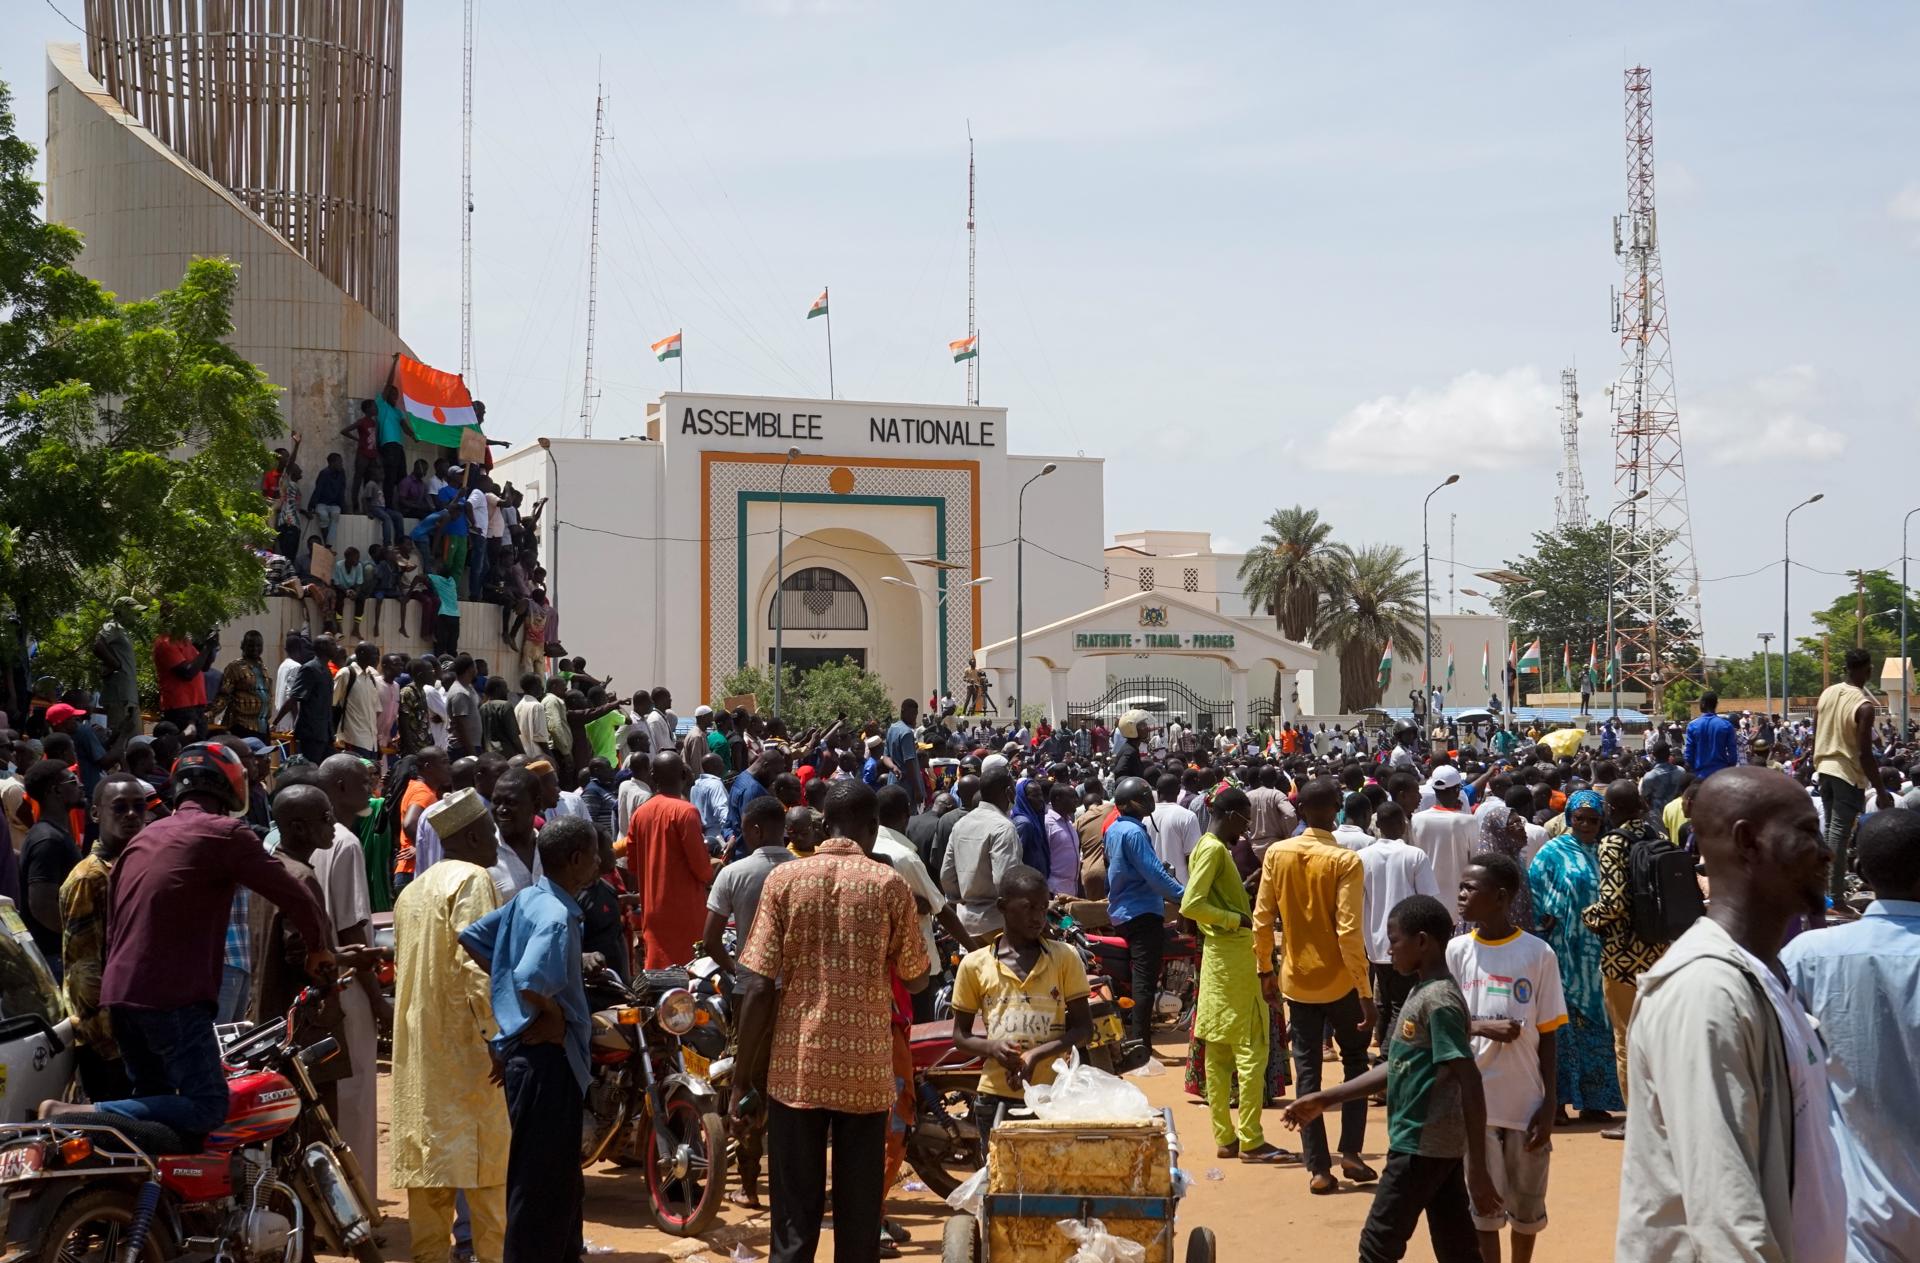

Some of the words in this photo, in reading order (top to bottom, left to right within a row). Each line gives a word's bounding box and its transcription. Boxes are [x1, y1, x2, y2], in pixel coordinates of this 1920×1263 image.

[681, 407, 823, 440] ASSEMBLEE
[870, 417, 995, 446] NATIONALE
[1076, 633, 1132, 649] FRATERNITE
[1144, 633, 1182, 649] TRAVAIL
[1192, 634, 1235, 649] PROGRES
